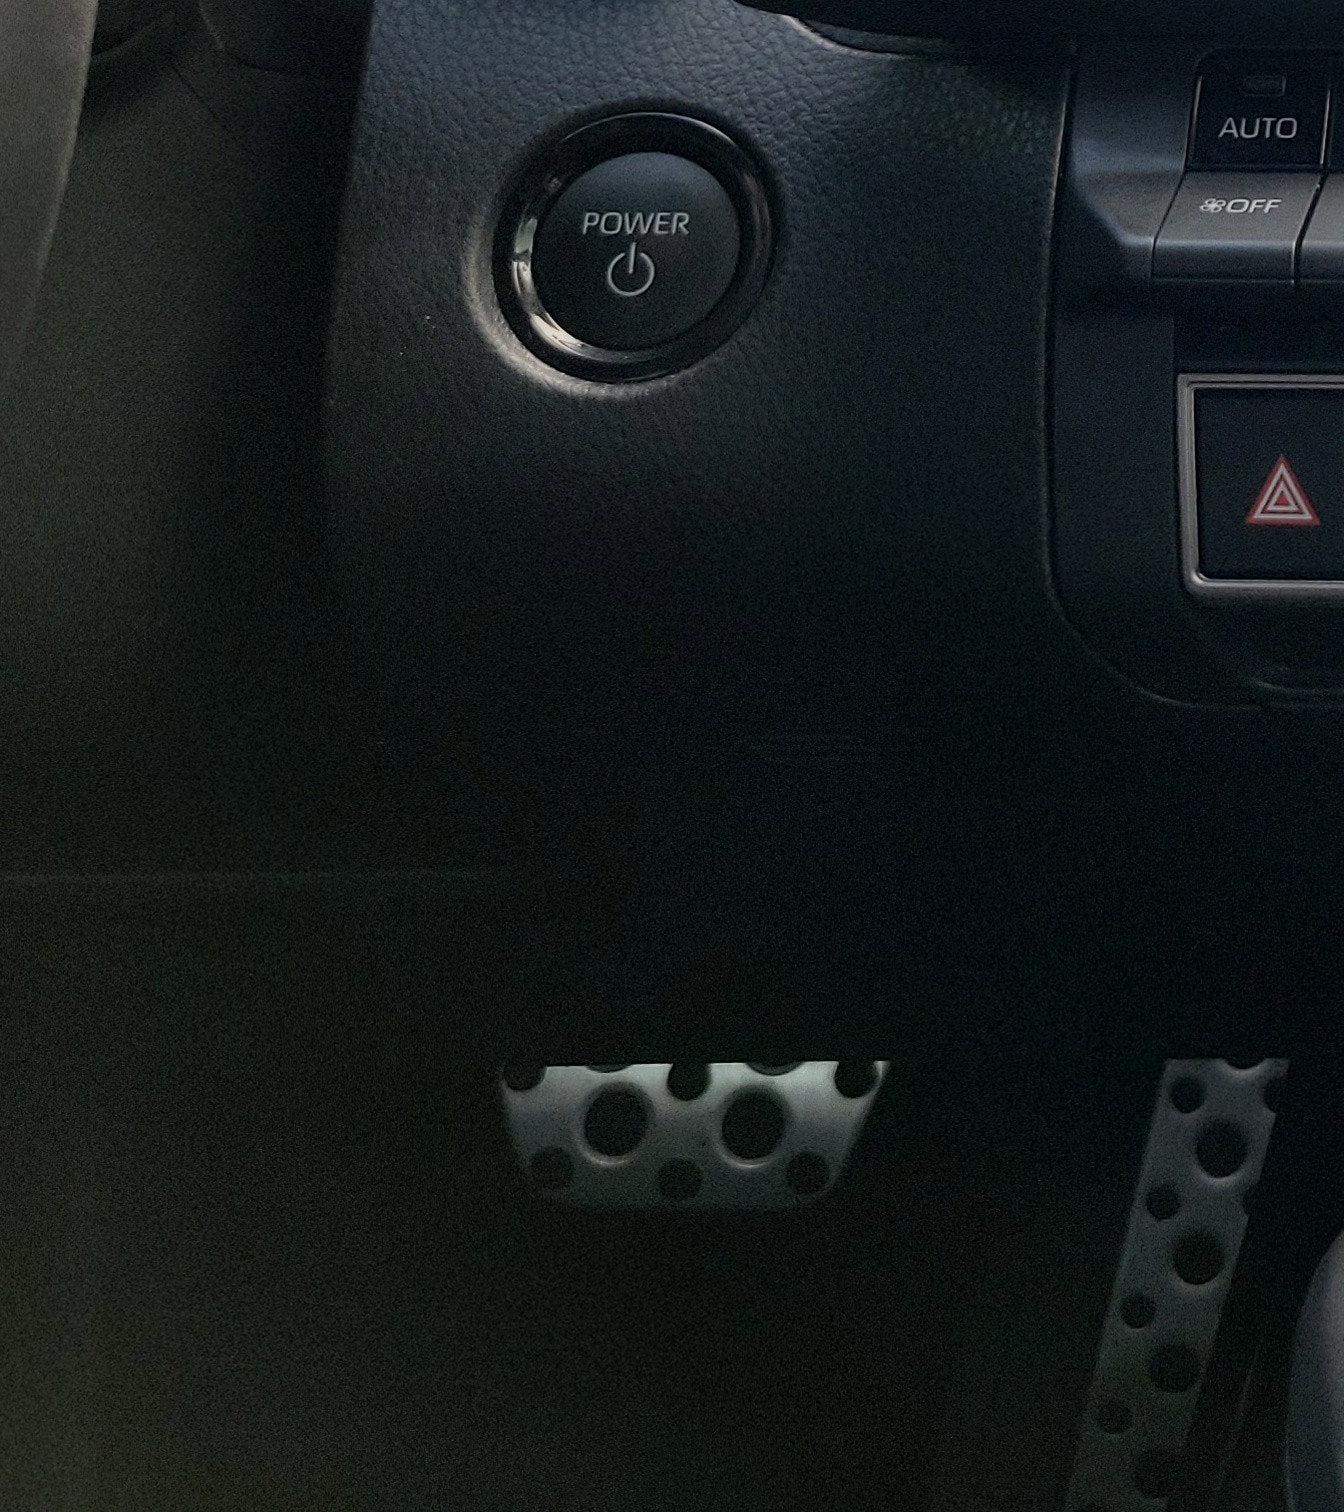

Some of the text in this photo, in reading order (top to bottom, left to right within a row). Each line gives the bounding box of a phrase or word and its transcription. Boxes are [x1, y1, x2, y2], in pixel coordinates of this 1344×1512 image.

[1218, 117, 1298, 139] AUTO
[1225, 198, 1282, 213] OFF
[582, 212, 690, 235] POWER
